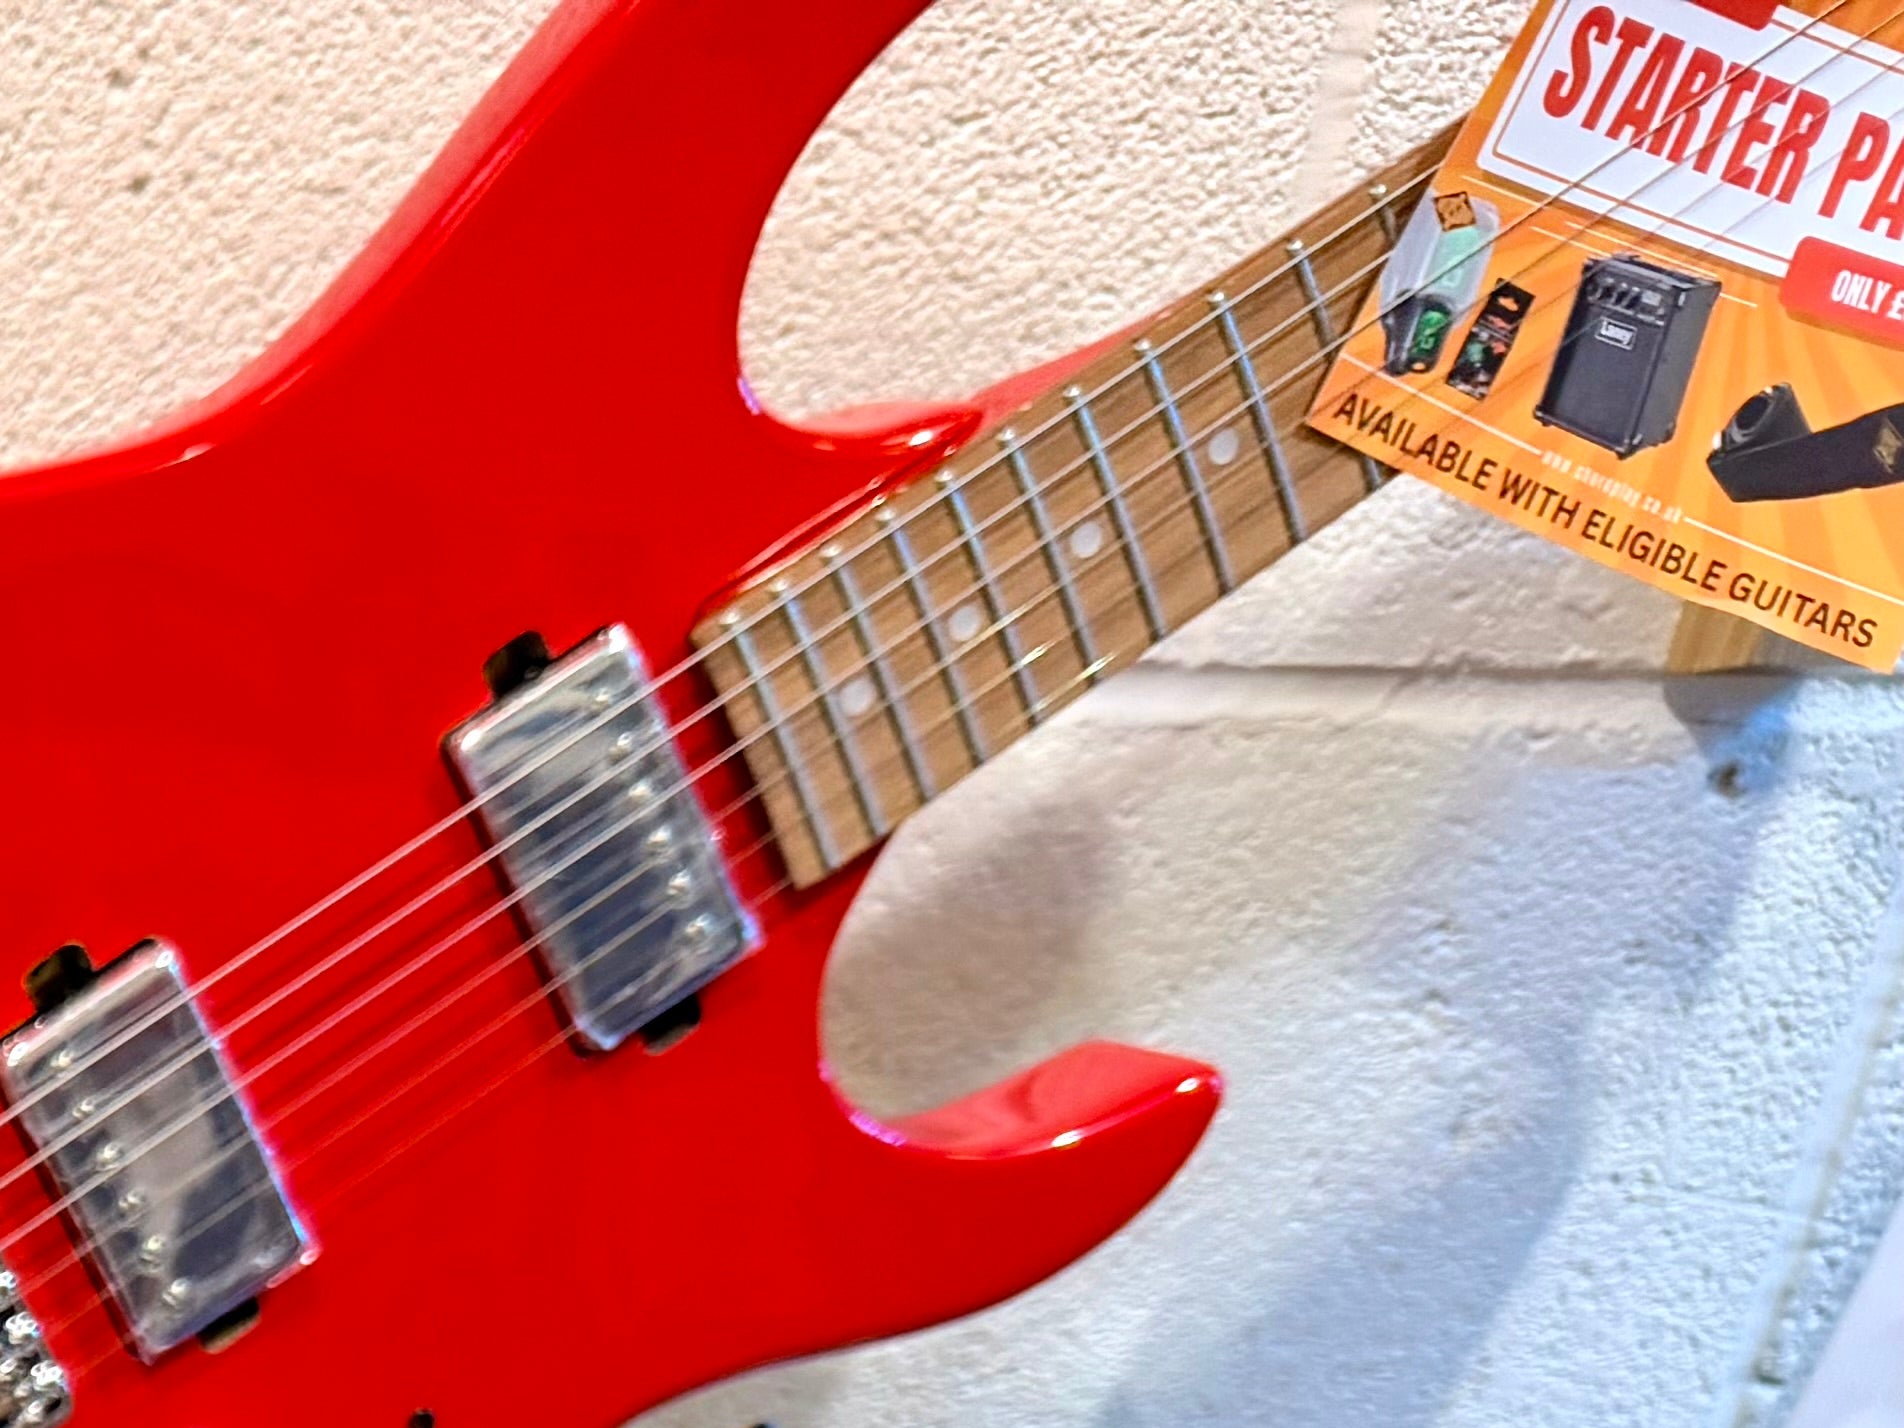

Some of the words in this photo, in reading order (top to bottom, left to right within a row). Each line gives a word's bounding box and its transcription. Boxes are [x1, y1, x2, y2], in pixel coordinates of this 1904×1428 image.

[1543, 6, 1831, 204] STARTER
[1831, 269, 1892, 315] ONLY
[1331, 391, 1494, 491] AVAILABLE
[1498, 470, 1577, 530] WITH
[1580, 508, 1728, 593] ELIGIBLE
[1727, 572, 1879, 649] GUITARS
